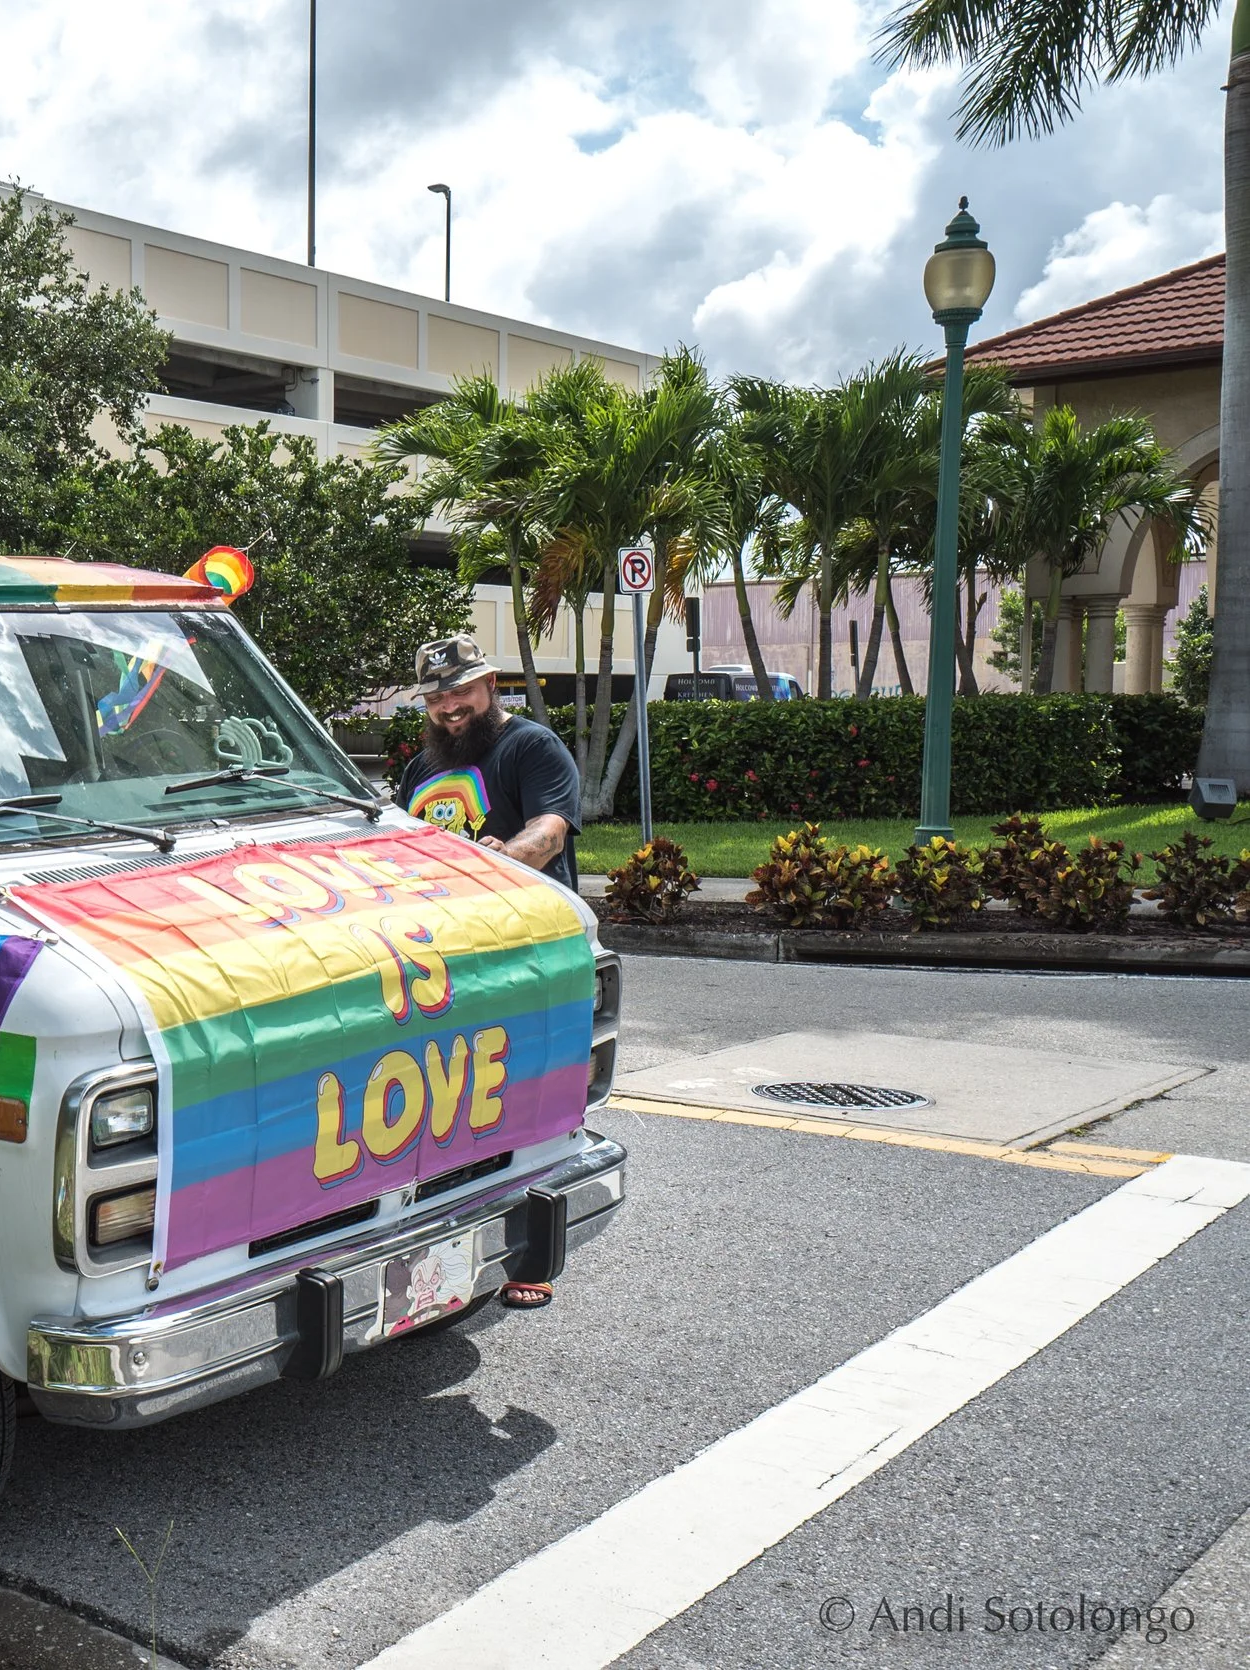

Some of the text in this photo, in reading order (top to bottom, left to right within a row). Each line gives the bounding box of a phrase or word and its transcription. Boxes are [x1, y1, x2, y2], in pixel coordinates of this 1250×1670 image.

[630, 558, 646, 583] P
[177, 850, 450, 927] LOVE
[350, 915, 453, 1025] IS
[312, 1025, 510, 1189] LOVE
